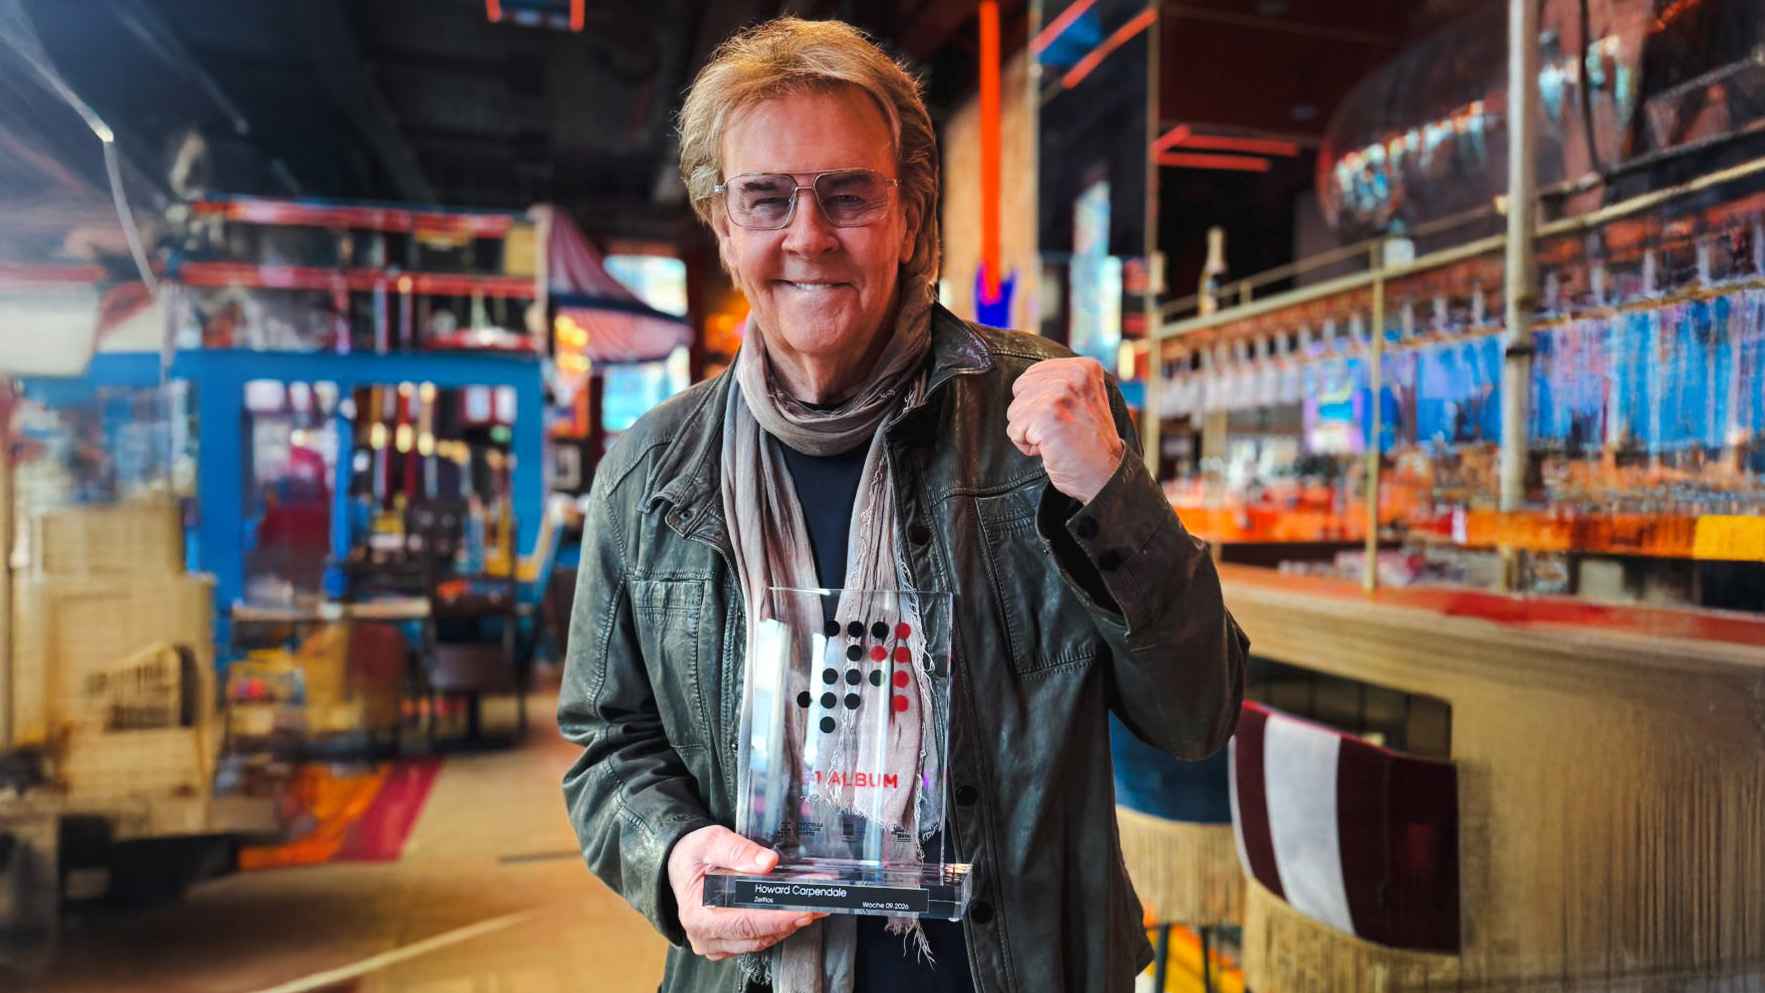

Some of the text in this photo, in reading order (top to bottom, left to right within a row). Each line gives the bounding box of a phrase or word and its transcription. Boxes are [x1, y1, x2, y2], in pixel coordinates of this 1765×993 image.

[827, 770, 898, 788] ALBUM
[754, 884, 848, 897] Howard Carpendale
